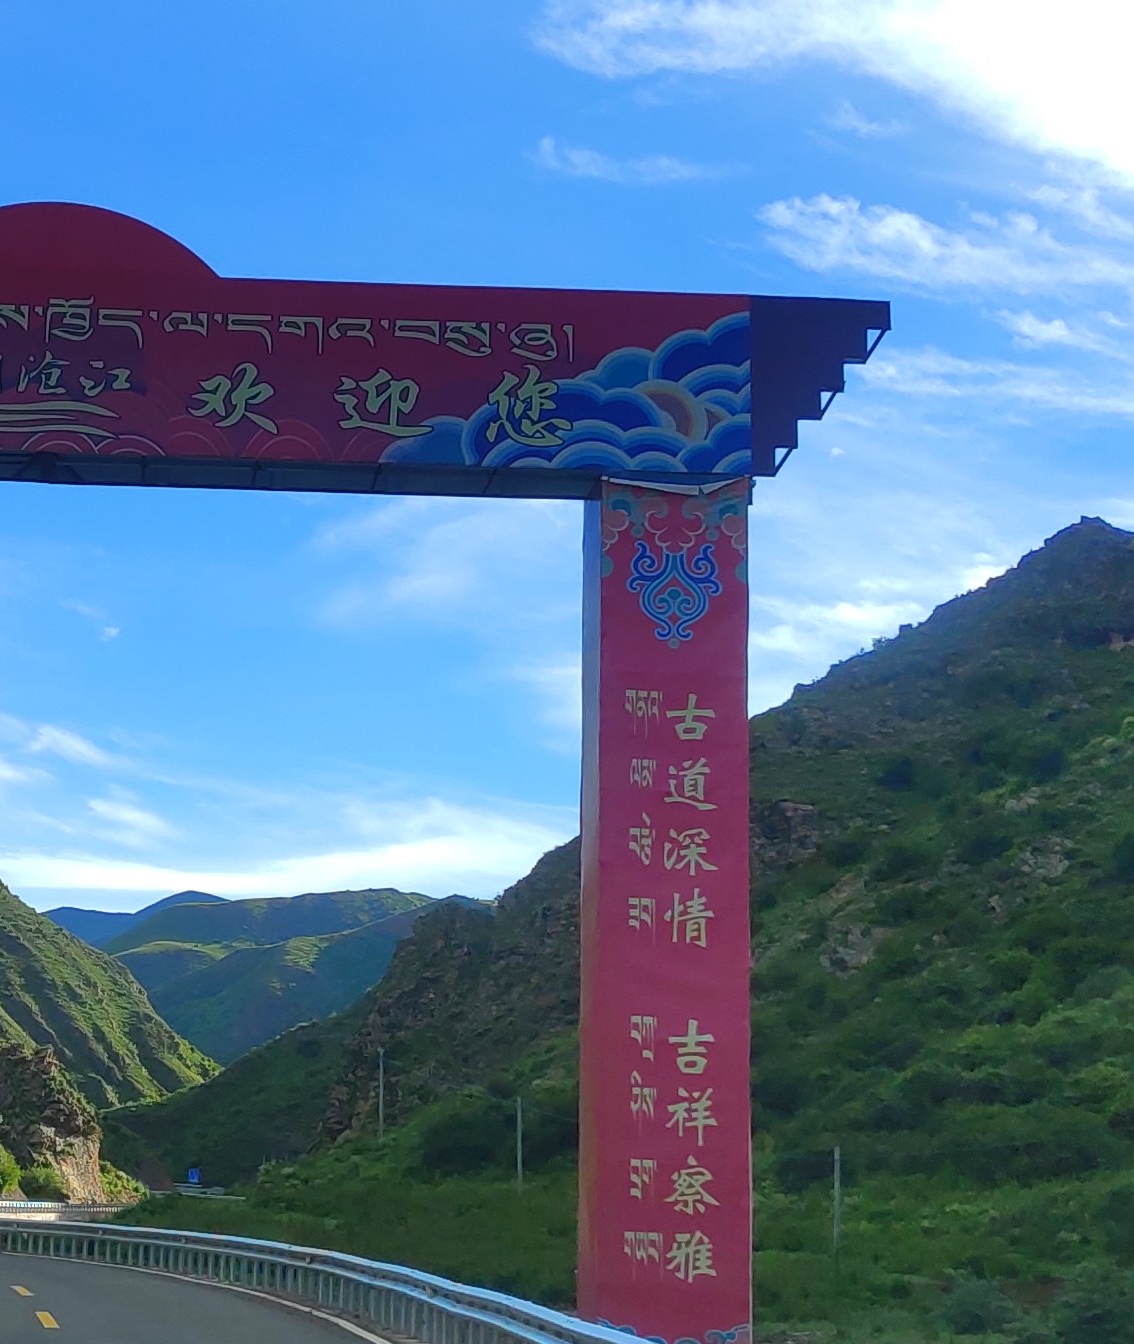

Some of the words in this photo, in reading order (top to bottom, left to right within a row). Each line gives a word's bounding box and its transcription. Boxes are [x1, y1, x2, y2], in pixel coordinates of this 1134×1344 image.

[187, 363, 572, 446] 欢迎您
[664, 694, 720, 948] 古道深情
[663, 1018, 721, 1284] 吉祥察雅
